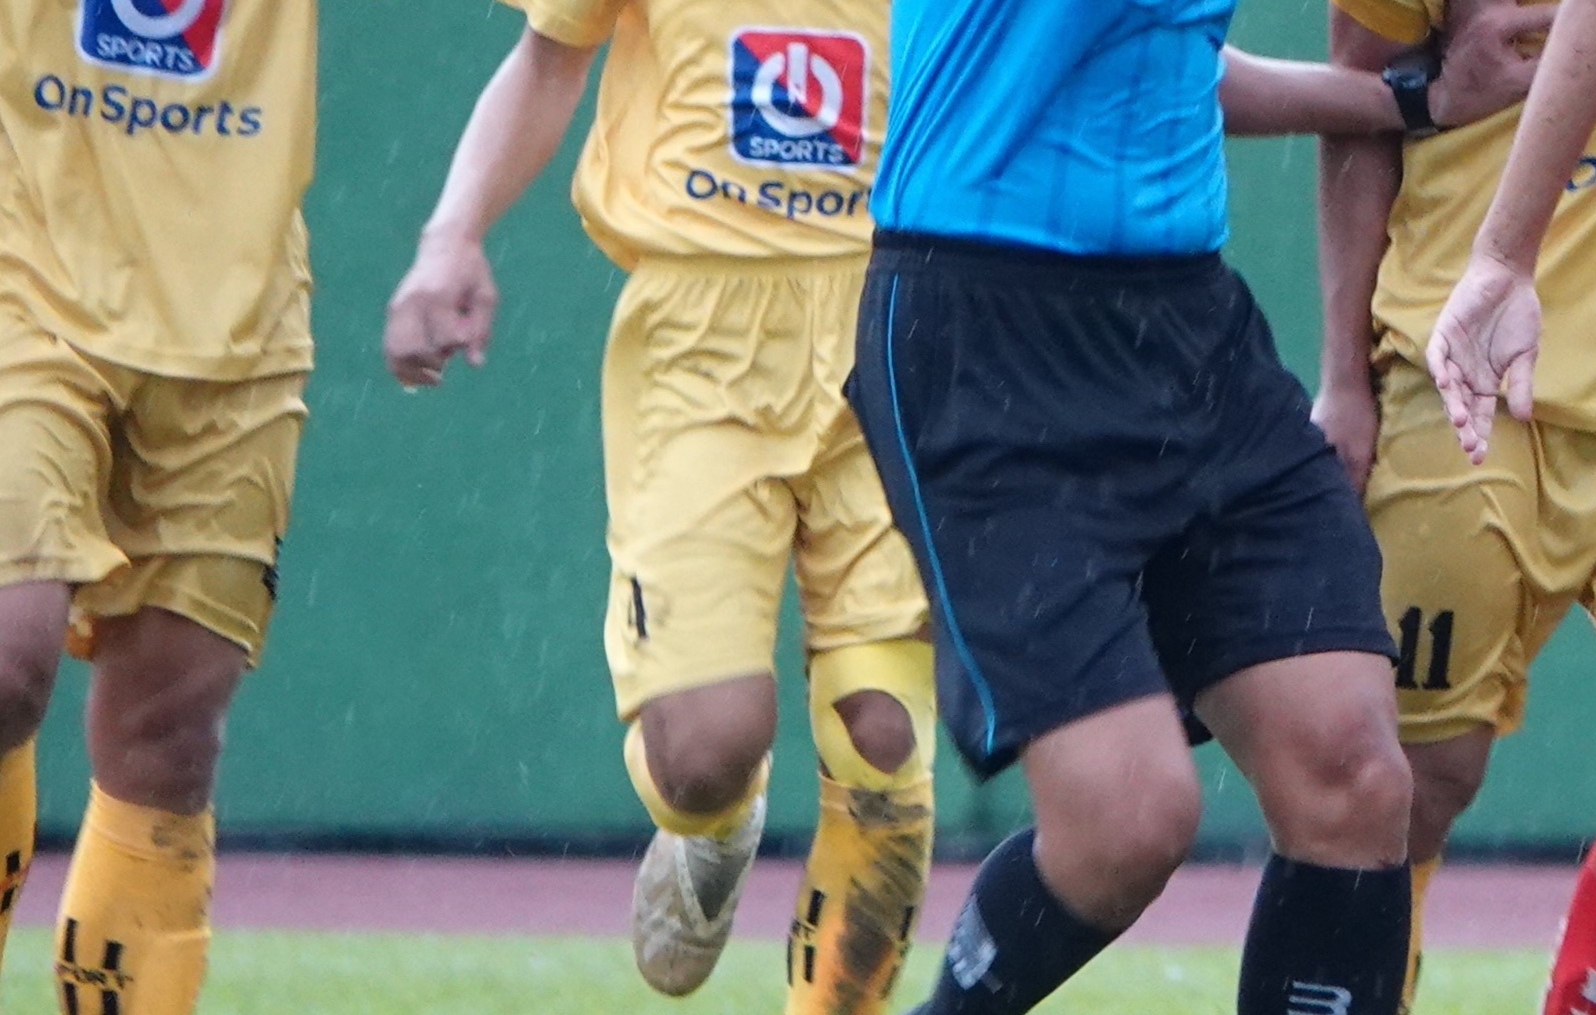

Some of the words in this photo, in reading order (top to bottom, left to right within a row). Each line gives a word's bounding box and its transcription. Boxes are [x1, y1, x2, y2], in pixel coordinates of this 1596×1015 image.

[97, 33, 194, 71] SPORTS
[750, 136, 844, 162] SPORTS
[1395, 606, 1453, 689] 11
